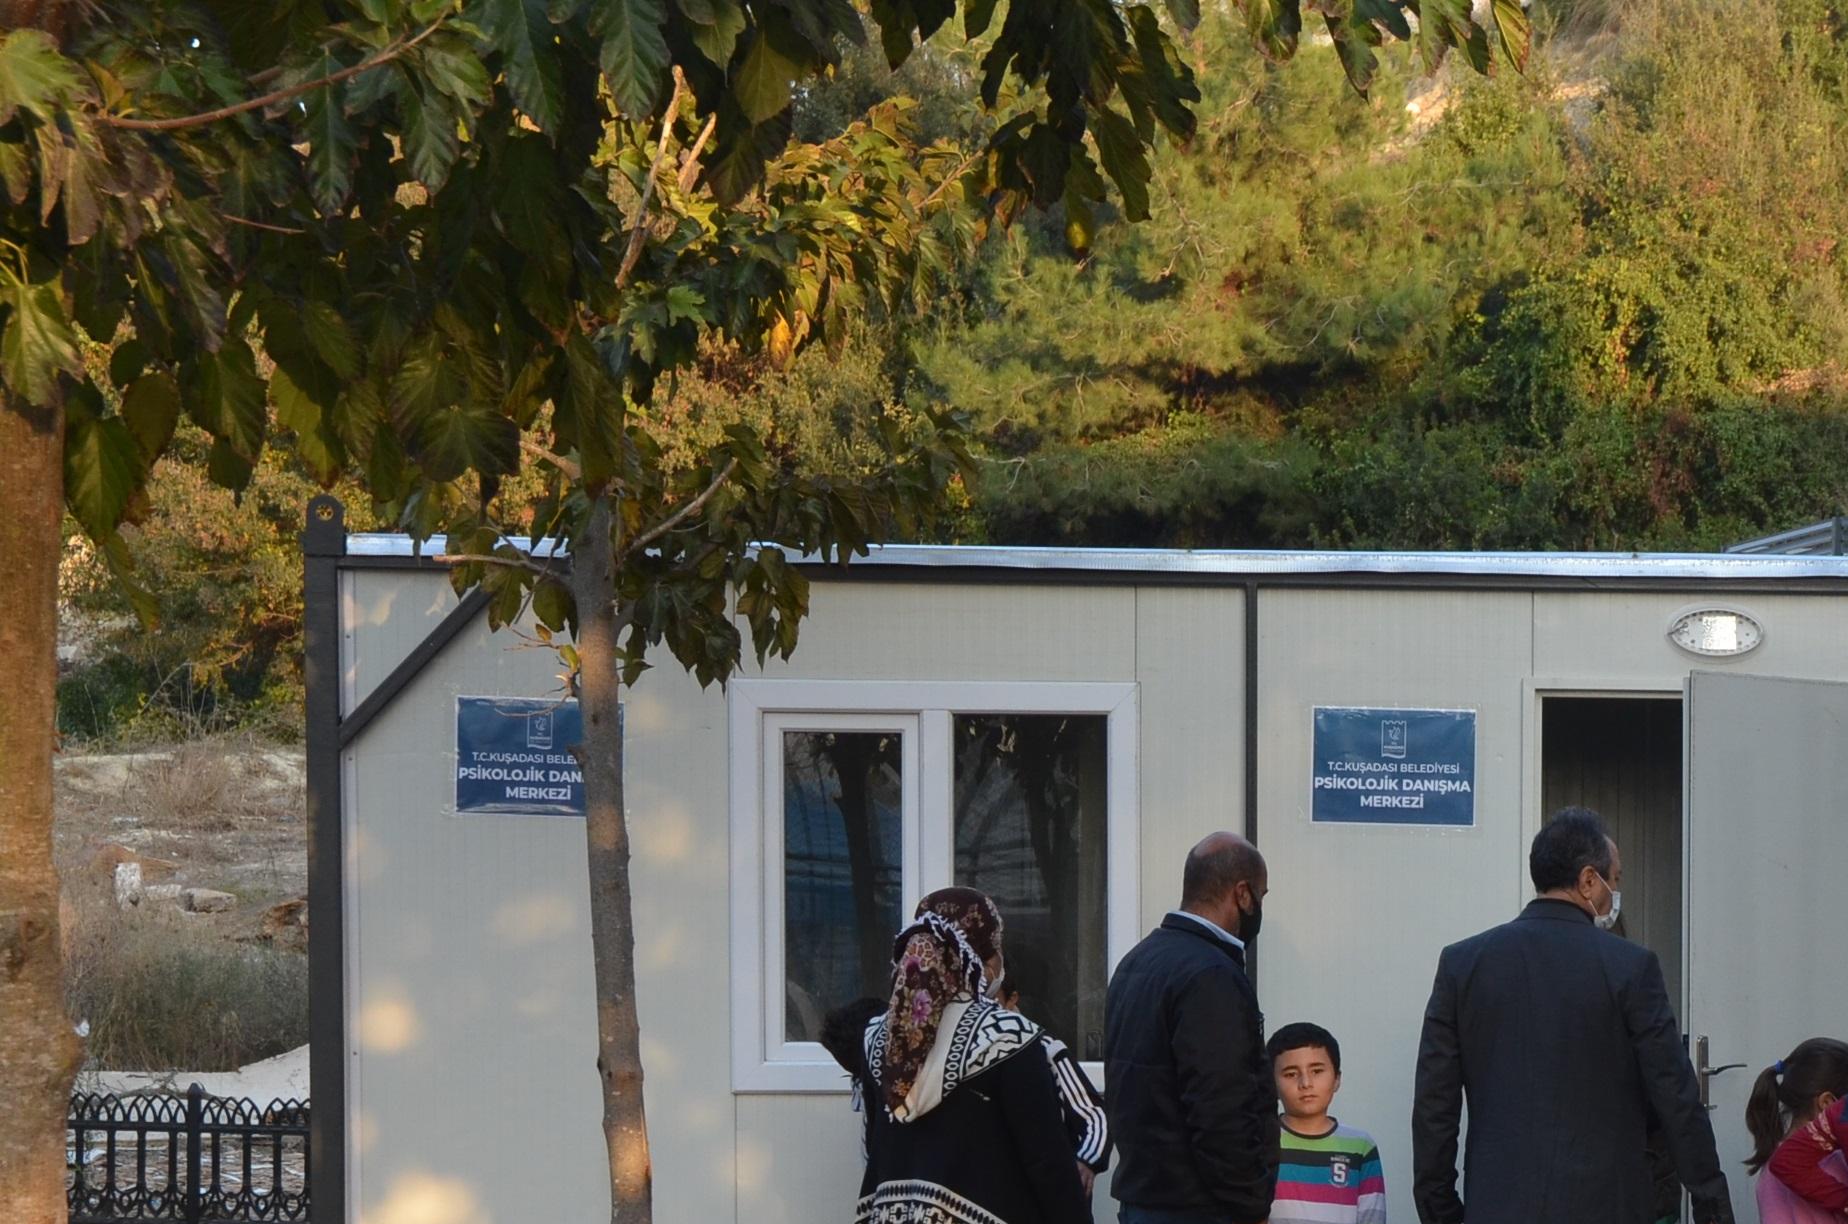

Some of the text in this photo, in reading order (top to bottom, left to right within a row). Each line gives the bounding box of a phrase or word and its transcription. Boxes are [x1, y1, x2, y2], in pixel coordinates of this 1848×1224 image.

[459, 764, 545, 782] PSİKOLOJİK
[1401, 762, 1460, 774] BELEDİYESİ
[505, 785, 571, 800] MERKEZİ
[1315, 774, 1471, 796] PSİKOLOJİK DANIŞMA
[1360, 793, 1424, 809] MERKEZİ
[1333, 1162, 1347, 1183] S
